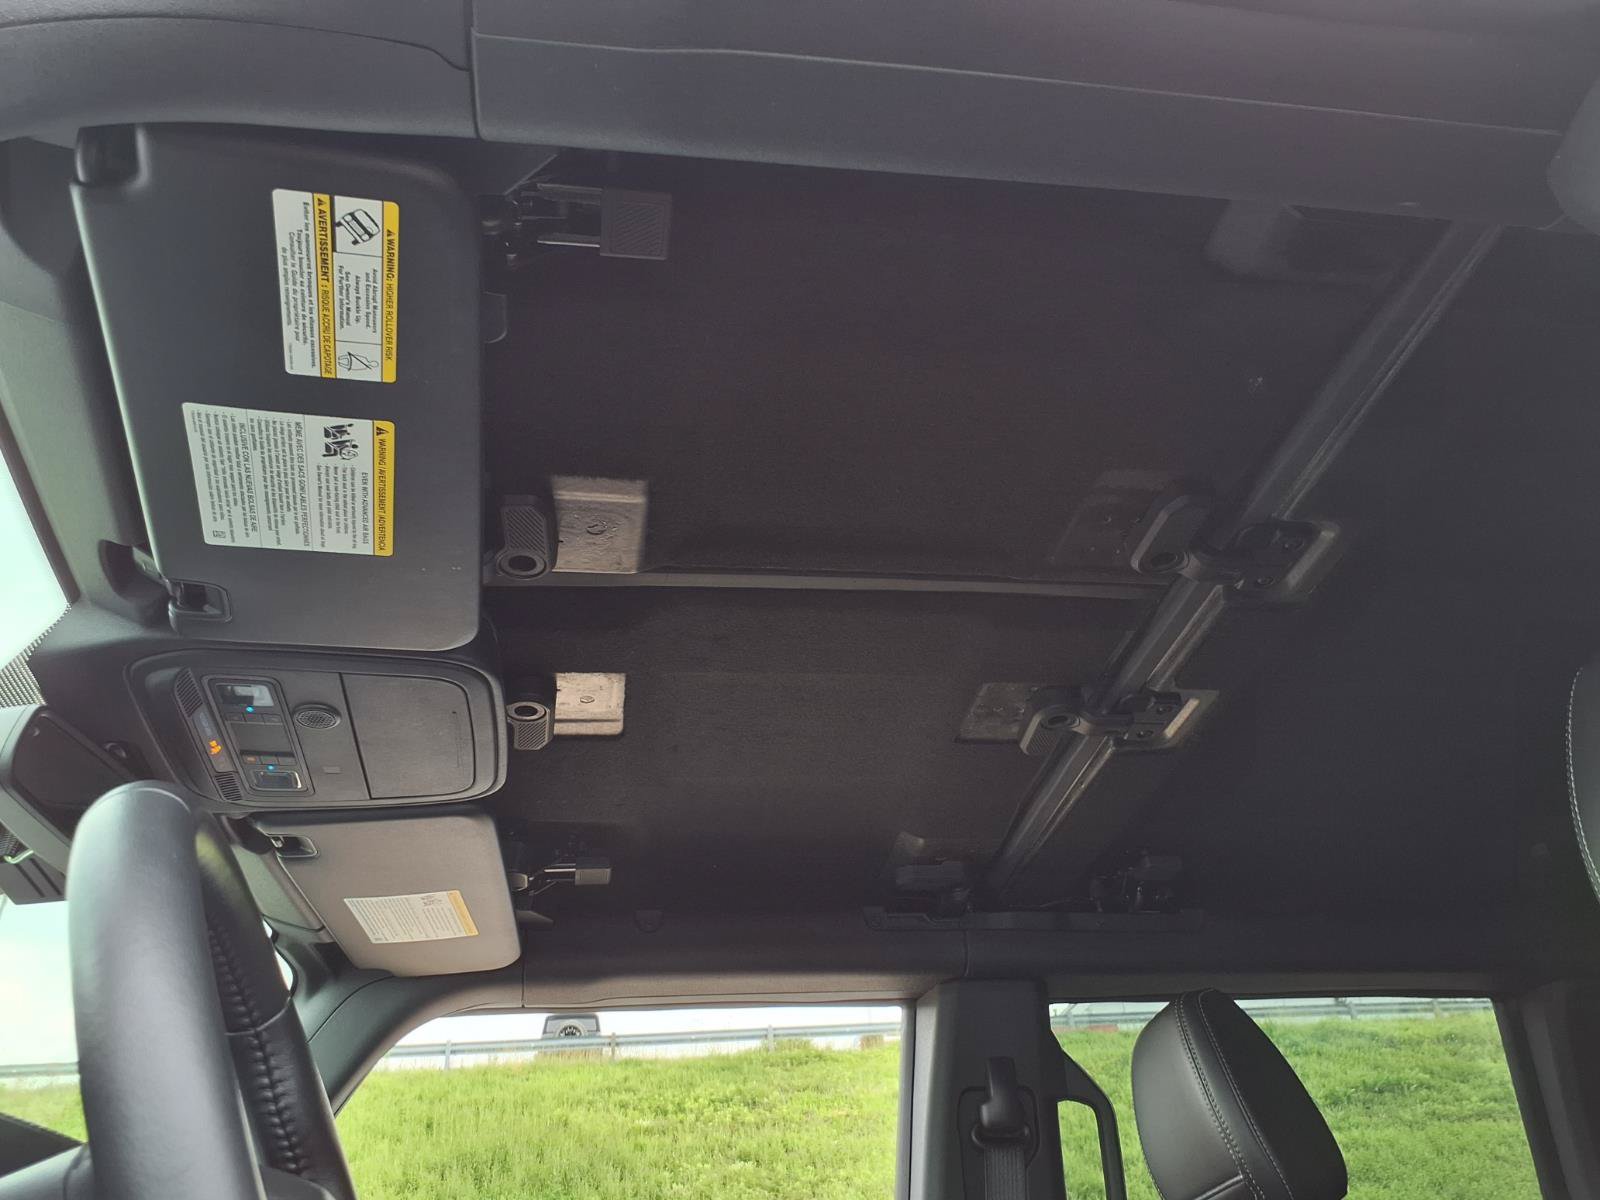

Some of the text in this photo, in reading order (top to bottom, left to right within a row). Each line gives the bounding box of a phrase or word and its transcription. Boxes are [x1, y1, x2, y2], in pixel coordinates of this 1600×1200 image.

[318, 208, 330, 283] AVERTISSEMENT
[321, 289, 331, 313] RISQUE
[385, 238, 396, 361] WARNING: HIGHER ROLLOVER RISK
[322, 313, 331, 335] ACCRU
[323, 335, 332, 344] DE
[323, 344, 333, 375] CAPOTAGE
[295, 438, 304, 453] AVEC
[378, 438, 387, 466] WARNING
[242, 451, 250, 463] CON
[296, 453, 305, 464] DES
[243, 463, 252, 474] LAS
[297, 464, 306, 478] SACS
